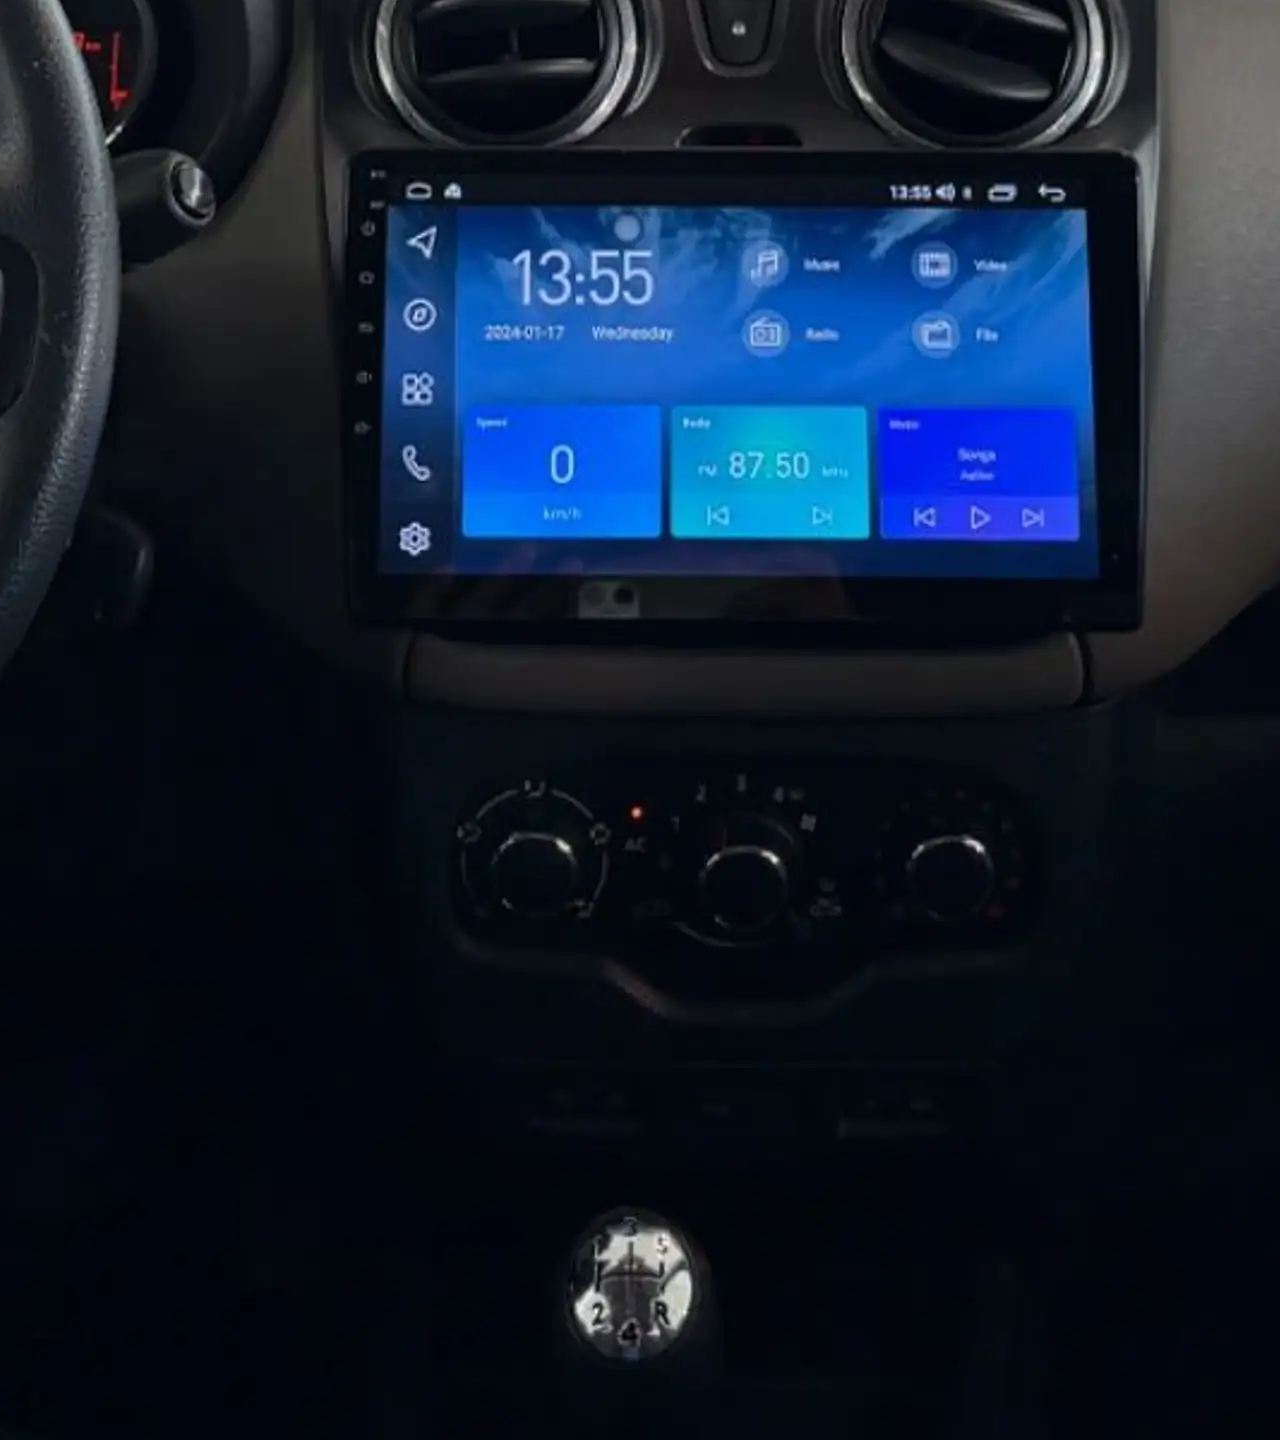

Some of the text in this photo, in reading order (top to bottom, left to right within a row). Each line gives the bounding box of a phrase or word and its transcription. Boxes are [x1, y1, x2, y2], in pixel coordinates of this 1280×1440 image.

[890, 184, 932, 201] 13:55
[512, 249, 654, 306] 13:55
[484, 324, 674, 343] 2024-01-17 Wednesday
[550, 444, 575, 485] 0
[728, 451, 810, 479] 87.50
[543, 506, 582, 521] km/h
[592, 1302, 605, 1327] 2
[654, 1301, 671, 1326] R
